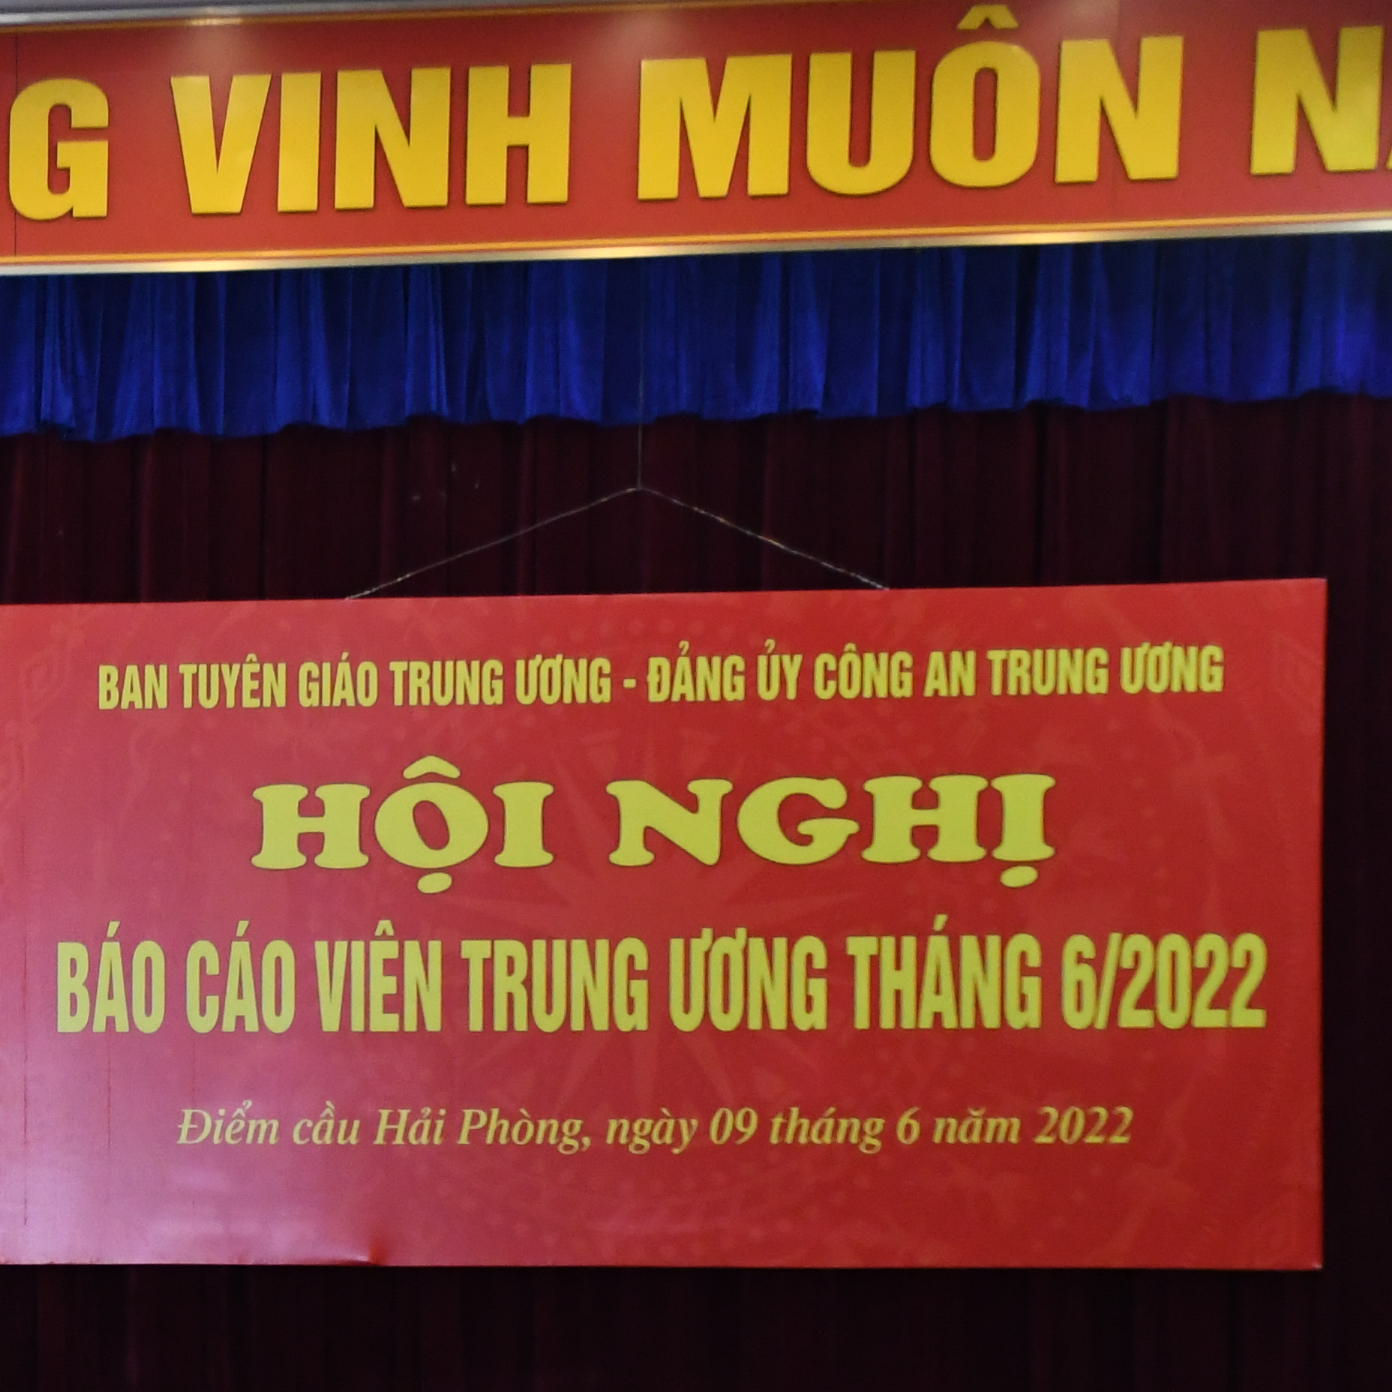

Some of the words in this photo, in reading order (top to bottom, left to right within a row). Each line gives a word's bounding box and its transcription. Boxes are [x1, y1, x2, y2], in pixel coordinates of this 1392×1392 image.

[171, 63, 573, 215] VINH
[637, 4, 1184, 202] MUÔN
[1250, 25, 1392, 176] N
[98, 665, 168, 711] BAN
[179, 654, 287, 709] TUYÊN
[299, 653, 379, 708] GIÁO
[390, 660, 504, 706] TRUNG
[516, 655, 613, 705] ƯƠNG
[647, 640, 745, 702] ĐẢNG
[757, 639, 804, 701] ỦY
[816, 643, 914, 700] CÔNG
[924, 650, 977, 698] AN
[988, 648, 1110, 697] TRUNG
[1121, 642, 1225, 694] ƯƠNG
[252, 755, 555, 897] HỘI
[606, 774, 1057, 889] NGHỊ
[56, 920, 166, 1034] BÁO
[185, 920, 297, 1034] CÁO
[314, 919, 443, 1033] VIÊN
[461, 937, 650, 1033] TRUNG
[669, 927, 829, 1032] ƯƠNG
[846, 914, 1043, 1031] THÁNG
[1061, 932, 1268, 1031] 6/2022
[176, 1100, 280, 1146] Điểm
[291, 1100, 361, 1146] cầu
[373, 1106, 447, 1146] Hải
[456, 1107, 592, 1155] Phòng,
[605, 1108, 698, 1155] ngày
[708, 1107, 758, 1145] 09
[769, 1105, 886, 1154] tháng
[895, 1107, 921, 1145] 6
[933, 1107, 1021, 1145] năm
[1035, 1106, 1134, 1145] 2022
